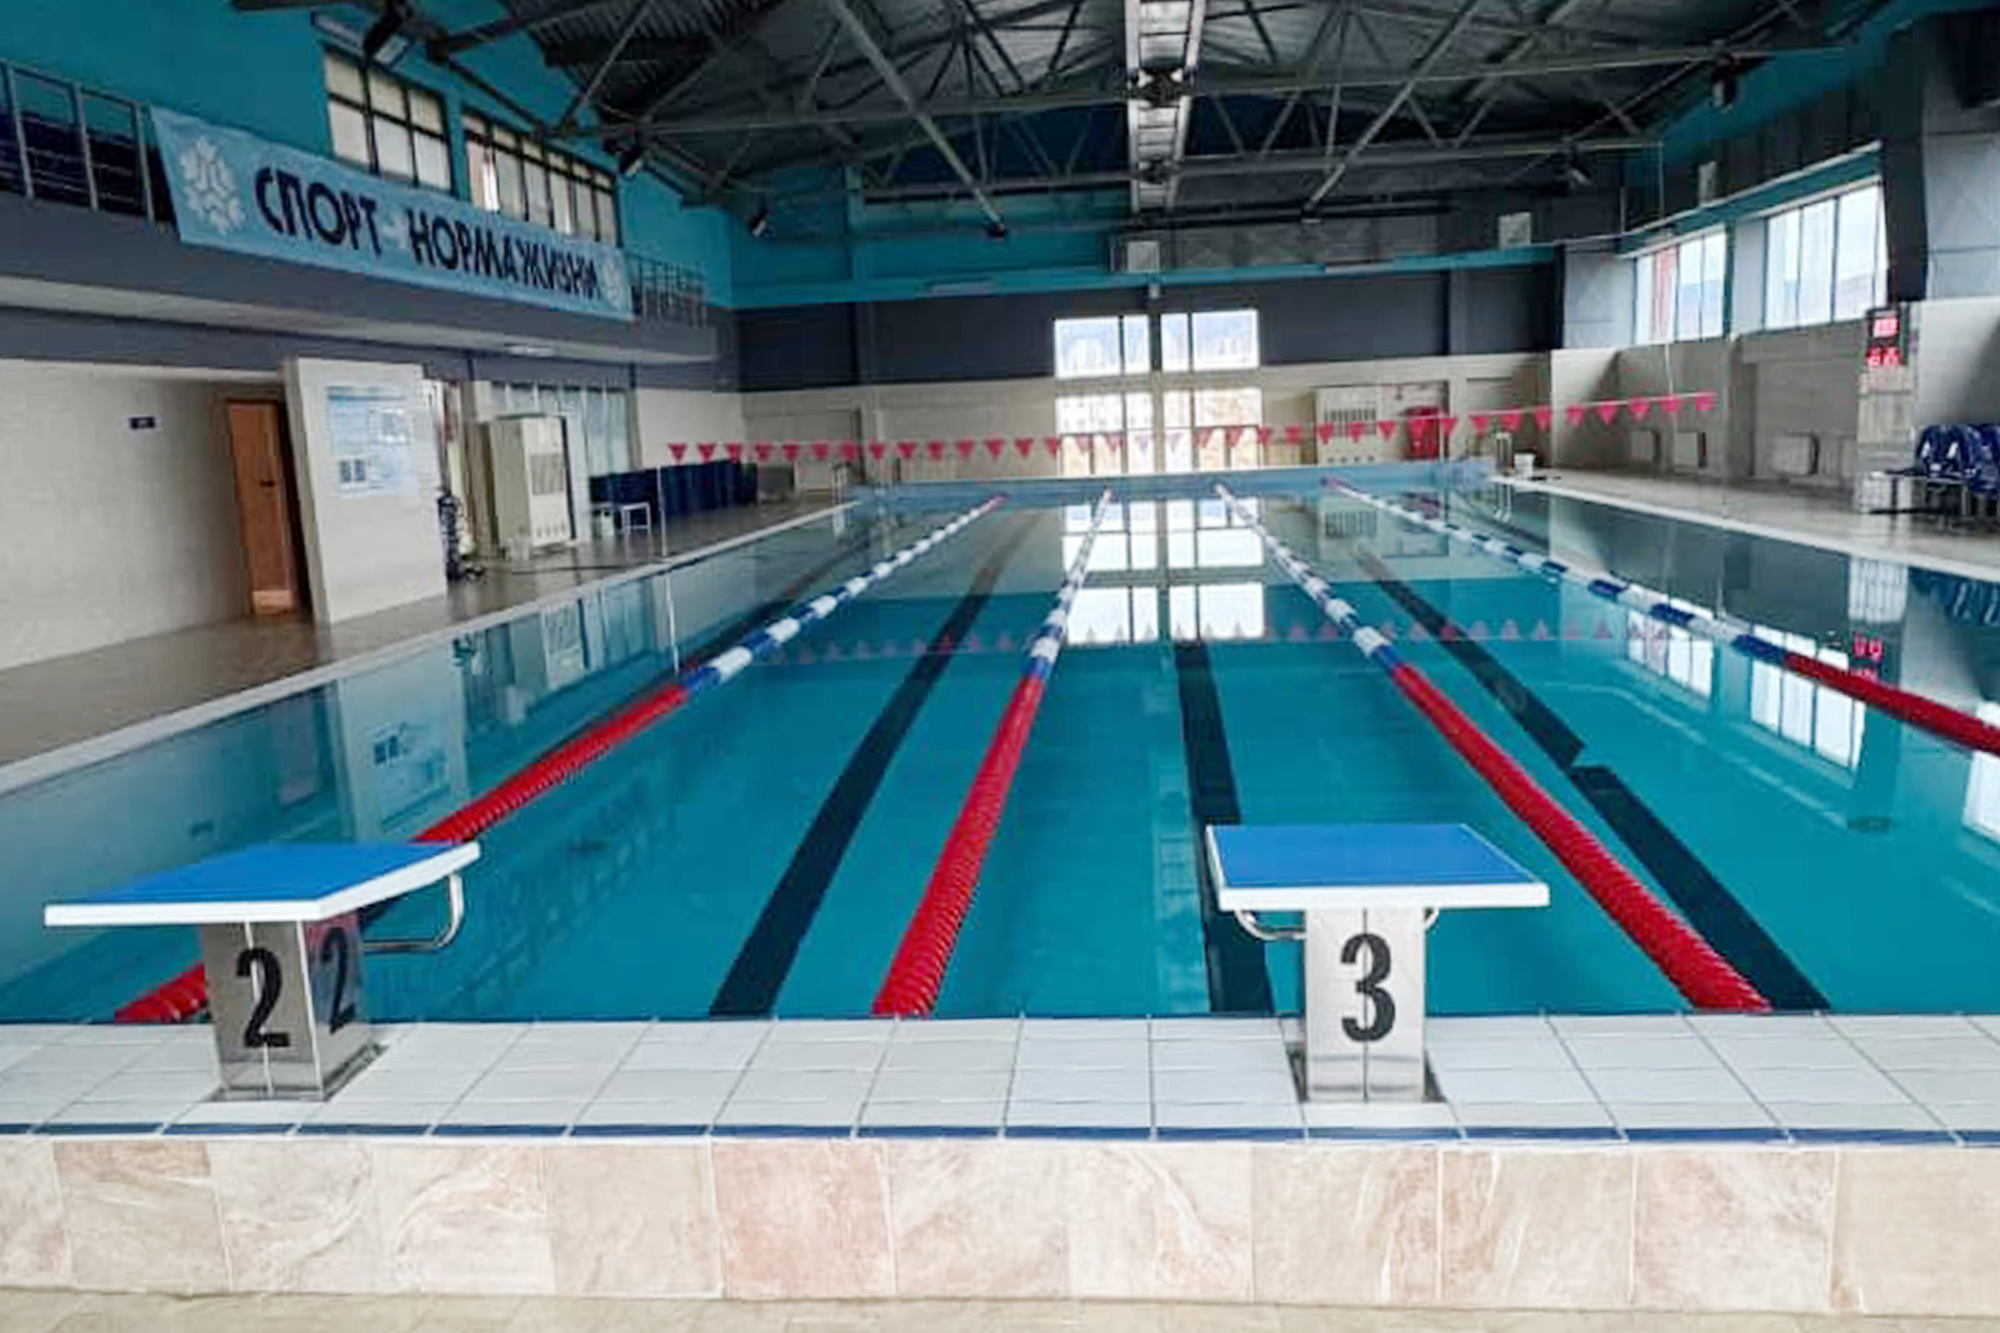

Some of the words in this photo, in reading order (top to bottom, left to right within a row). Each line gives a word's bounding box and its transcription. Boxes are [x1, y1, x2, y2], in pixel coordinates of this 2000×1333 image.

[255, 166, 382, 256] СПОРТ
[406, 208, 519, 282] НОРМА
[516, 238, 600, 299] ЖИЗНИ
[237, 947, 290, 1047] 2
[321, 927, 356, 1034] 2
[1341, 932, 1396, 1043] 3
